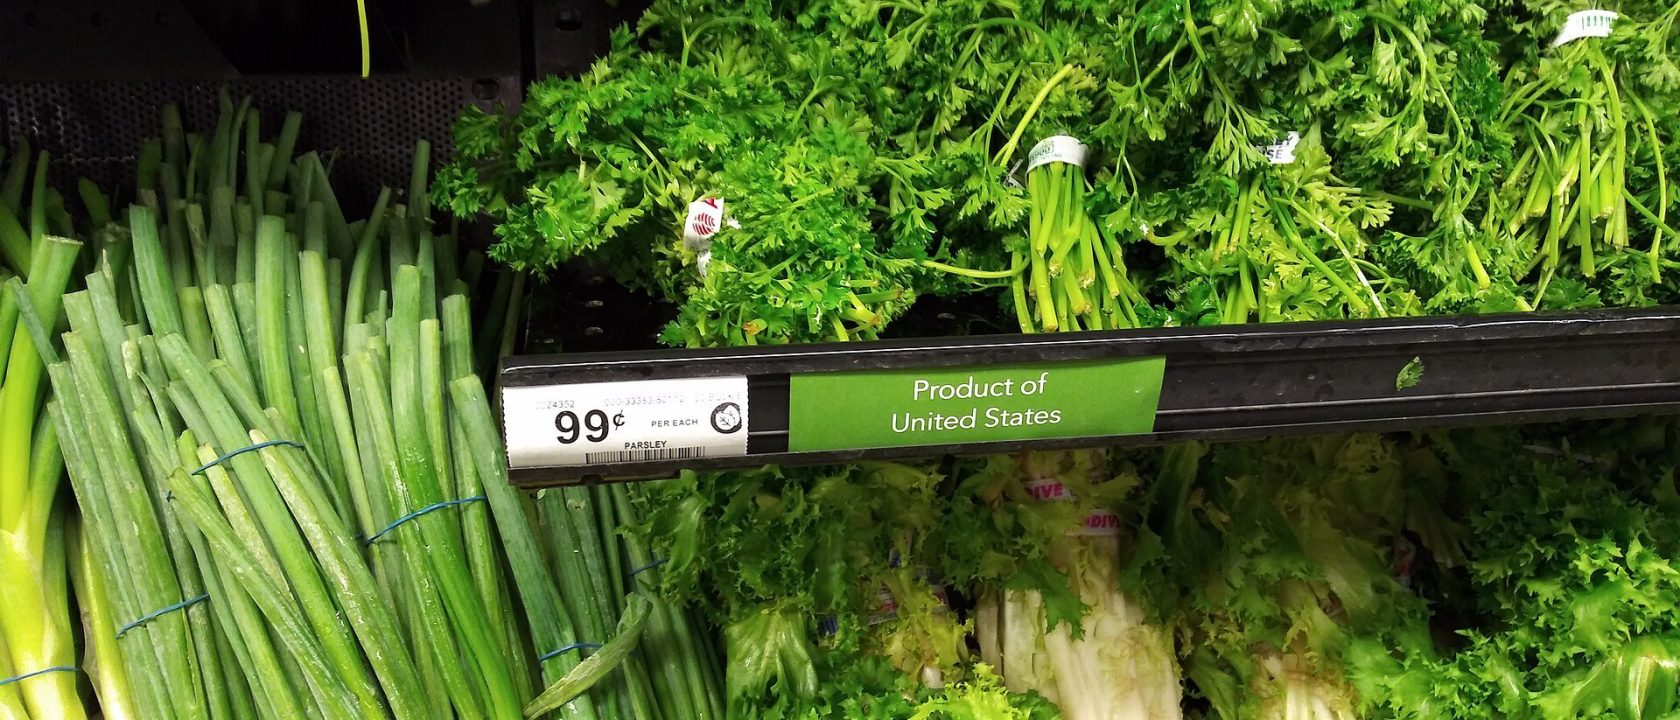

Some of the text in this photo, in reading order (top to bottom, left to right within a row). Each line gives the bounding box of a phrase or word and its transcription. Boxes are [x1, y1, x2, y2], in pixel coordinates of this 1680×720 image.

[913, 371, 1049, 401] Product of
[554, 408, 626, 445] 99¢
[651, 418, 699, 428] PER EACH
[891, 405, 1062, 433] United States
[624, 440, 668, 450] PARSLEY
